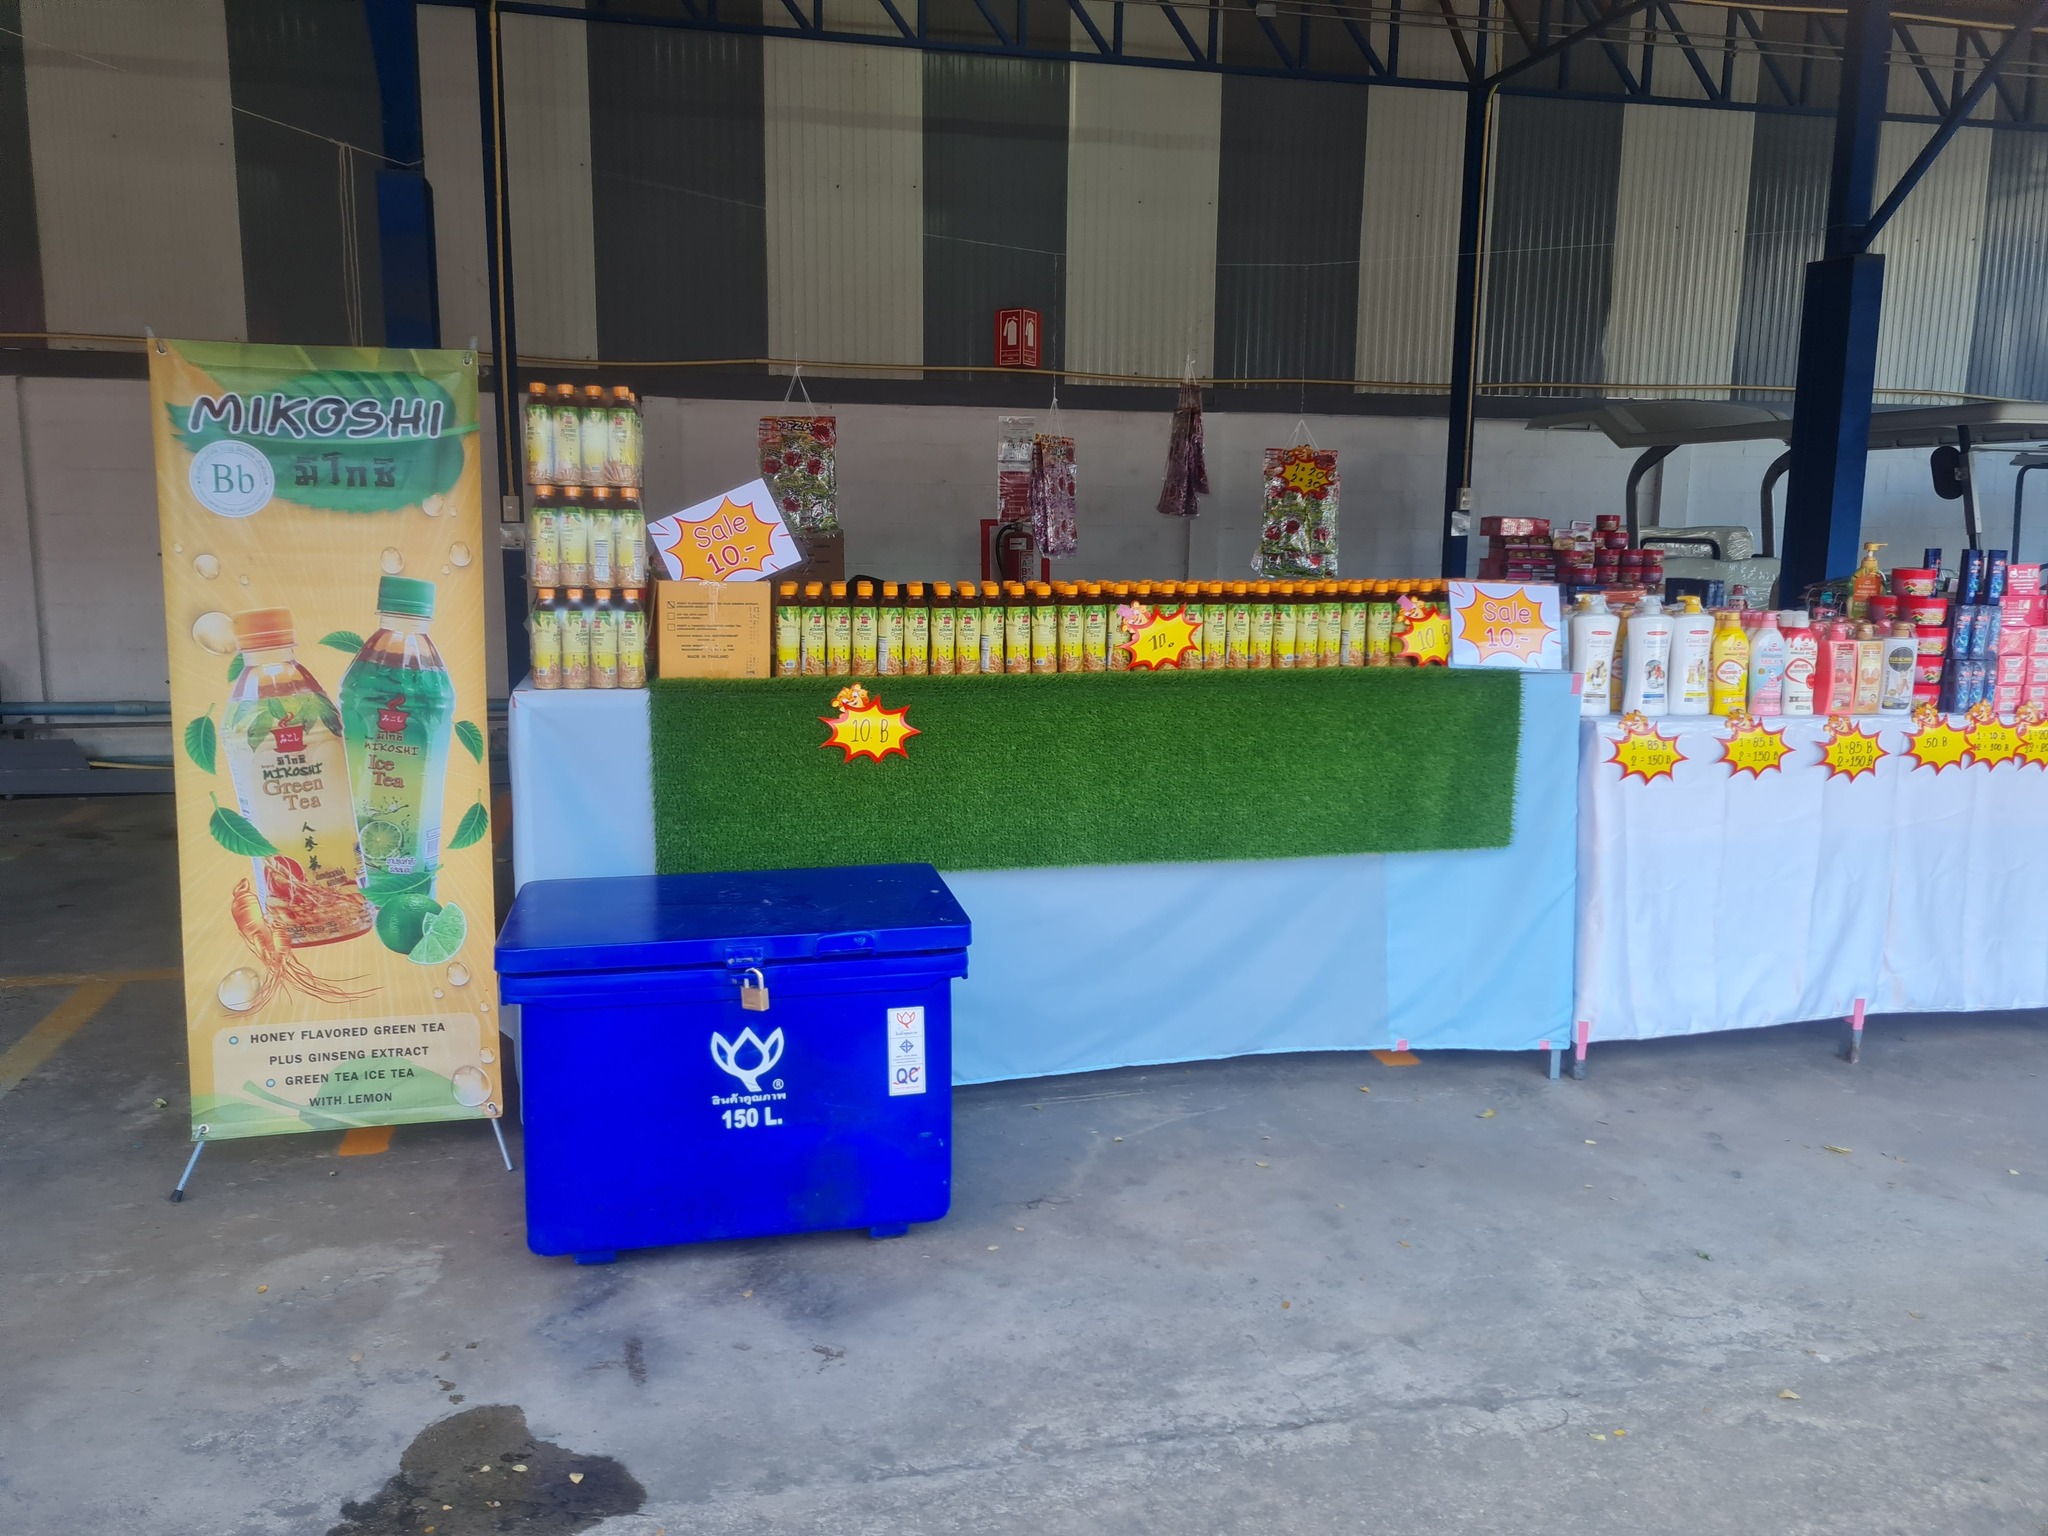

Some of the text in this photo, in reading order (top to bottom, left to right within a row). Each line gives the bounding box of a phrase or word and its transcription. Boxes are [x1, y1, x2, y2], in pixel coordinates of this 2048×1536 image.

[188, 392, 444, 439] MIKOSHI
[211, 463, 255, 494] Bb
[1308, 467, 1325, 479] 20
[1305, 479, 1321, 489] 30
[693, 514, 748, 549] Sale
[1483, 601, 1532, 624] Sale
[880, 718, 889, 743] B
[364, 742, 420, 756] MIKOSHI
[1647, 740, 1659, 751] 85
[1849, 741, 1863, 755] 85
[1866, 741, 1873, 754] B
[1923, 736, 1948, 748] 50 B
[263, 762, 323, 780] MIKOSHI
[368, 754, 395, 772] Ice
[262, 777, 324, 796] Green
[373, 771, 405, 789] Tea
[283, 794, 322, 811] Tea
[250, 1022, 446, 1044] HONEY FLAVORED GREEN TEA
[269, 1046, 429, 1066] PLUS GINSENG EXTRACT
[284, 1068, 415, 1087] GREEN TEA ICE TEA
[309, 1092, 393, 1108] WITH LEMON
[722, 1106, 783, 1129] 150 L.
